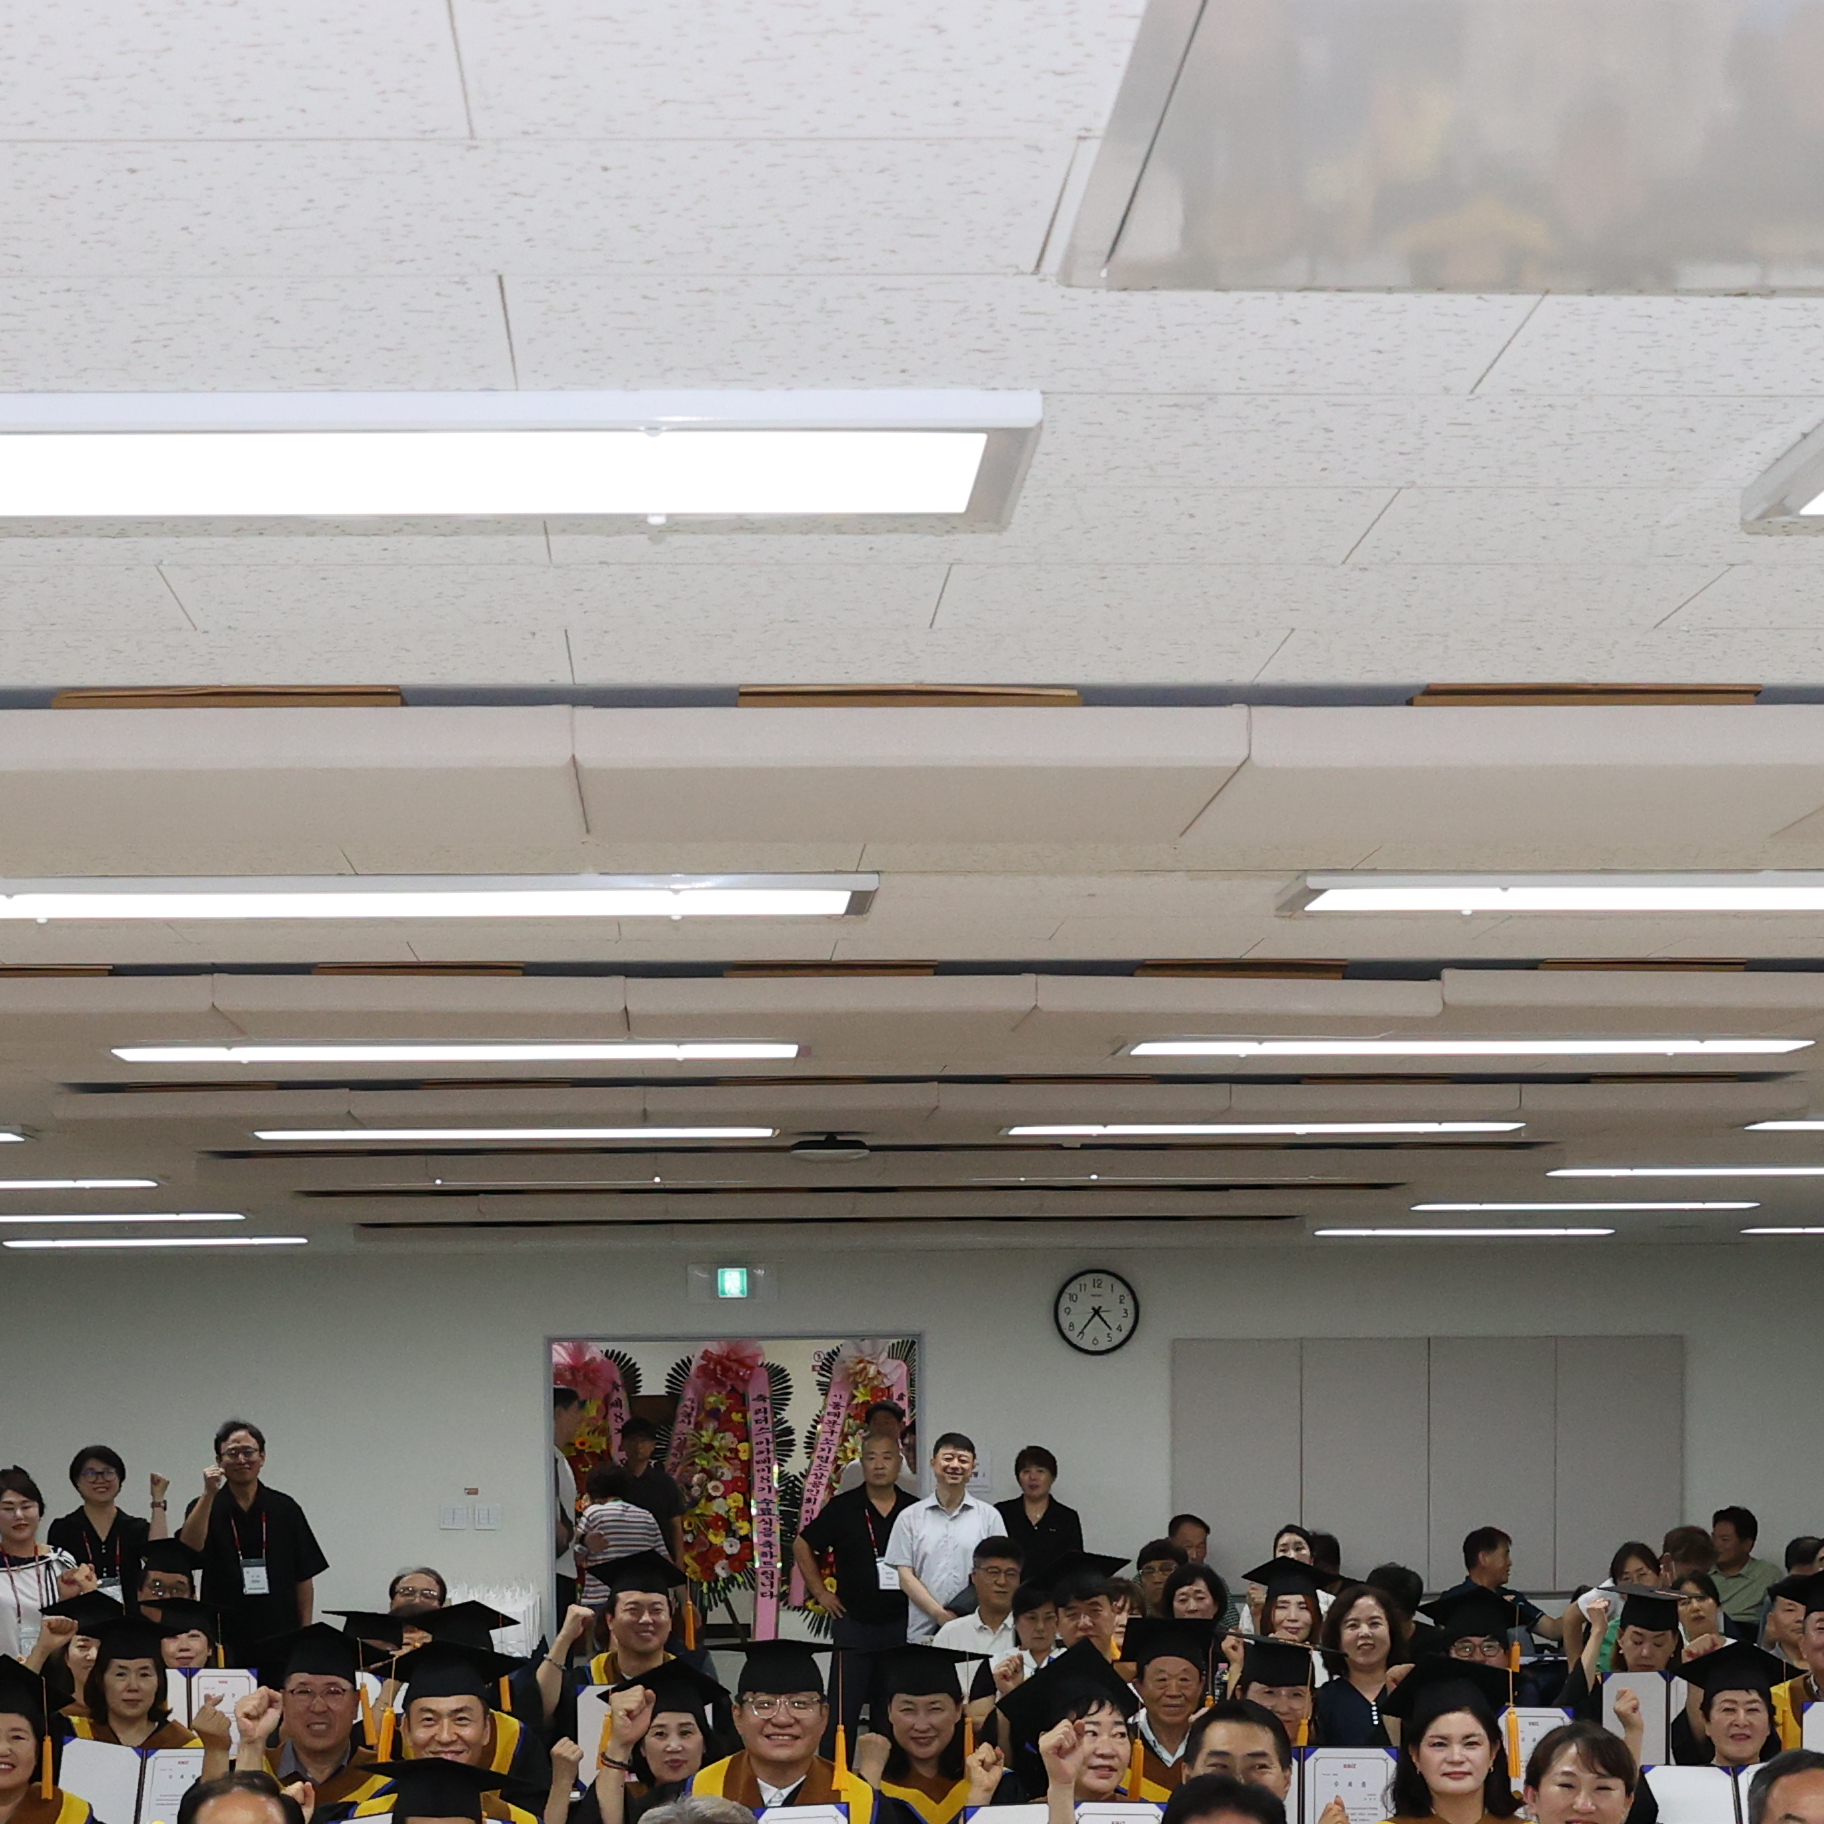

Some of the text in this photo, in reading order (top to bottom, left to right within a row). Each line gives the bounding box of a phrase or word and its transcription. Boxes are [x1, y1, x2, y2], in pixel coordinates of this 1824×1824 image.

[1079, 1283, 1087, 1292] 11
[1093, 1279, 1103, 1288] 12
[1068, 1293, 1078, 1302] 10
[1064, 1306, 1071, 1315] 9
[1122, 1308, 1128, 1318] 3
[1068, 1322, 1075, 1331] 8
[1116, 1324, 1123, 1332] 4
[1092, 1336, 1099, 1345] 6
[1107, 1333, 1113, 1342] 5
